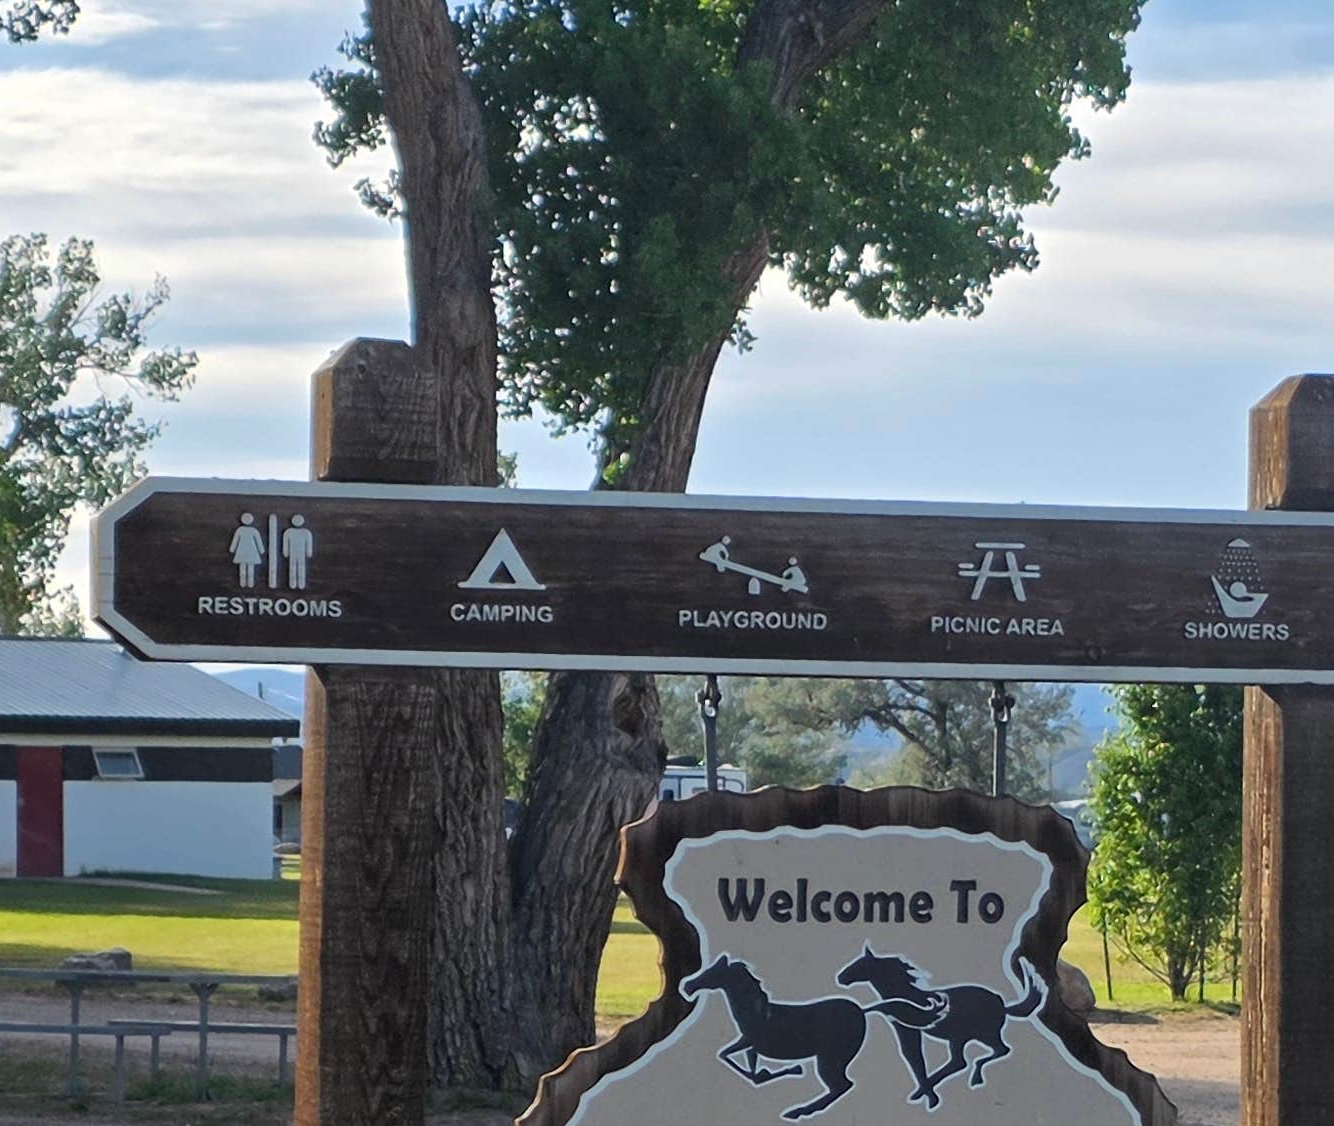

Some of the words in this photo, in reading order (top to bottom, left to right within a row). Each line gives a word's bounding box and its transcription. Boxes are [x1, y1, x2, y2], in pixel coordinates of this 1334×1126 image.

[197, 596, 343, 618] RESTROOMS
[450, 602, 554, 624] CAMPING
[678, 610, 828, 631] PLAYGROUND
[930, 615, 1001, 635] PICNIC
[1005, 617, 1065, 637] AREA
[1184, 622, 1290, 642] SHOWERS
[718, 877, 934, 924] Welcome
[949, 880, 1005, 924] To
